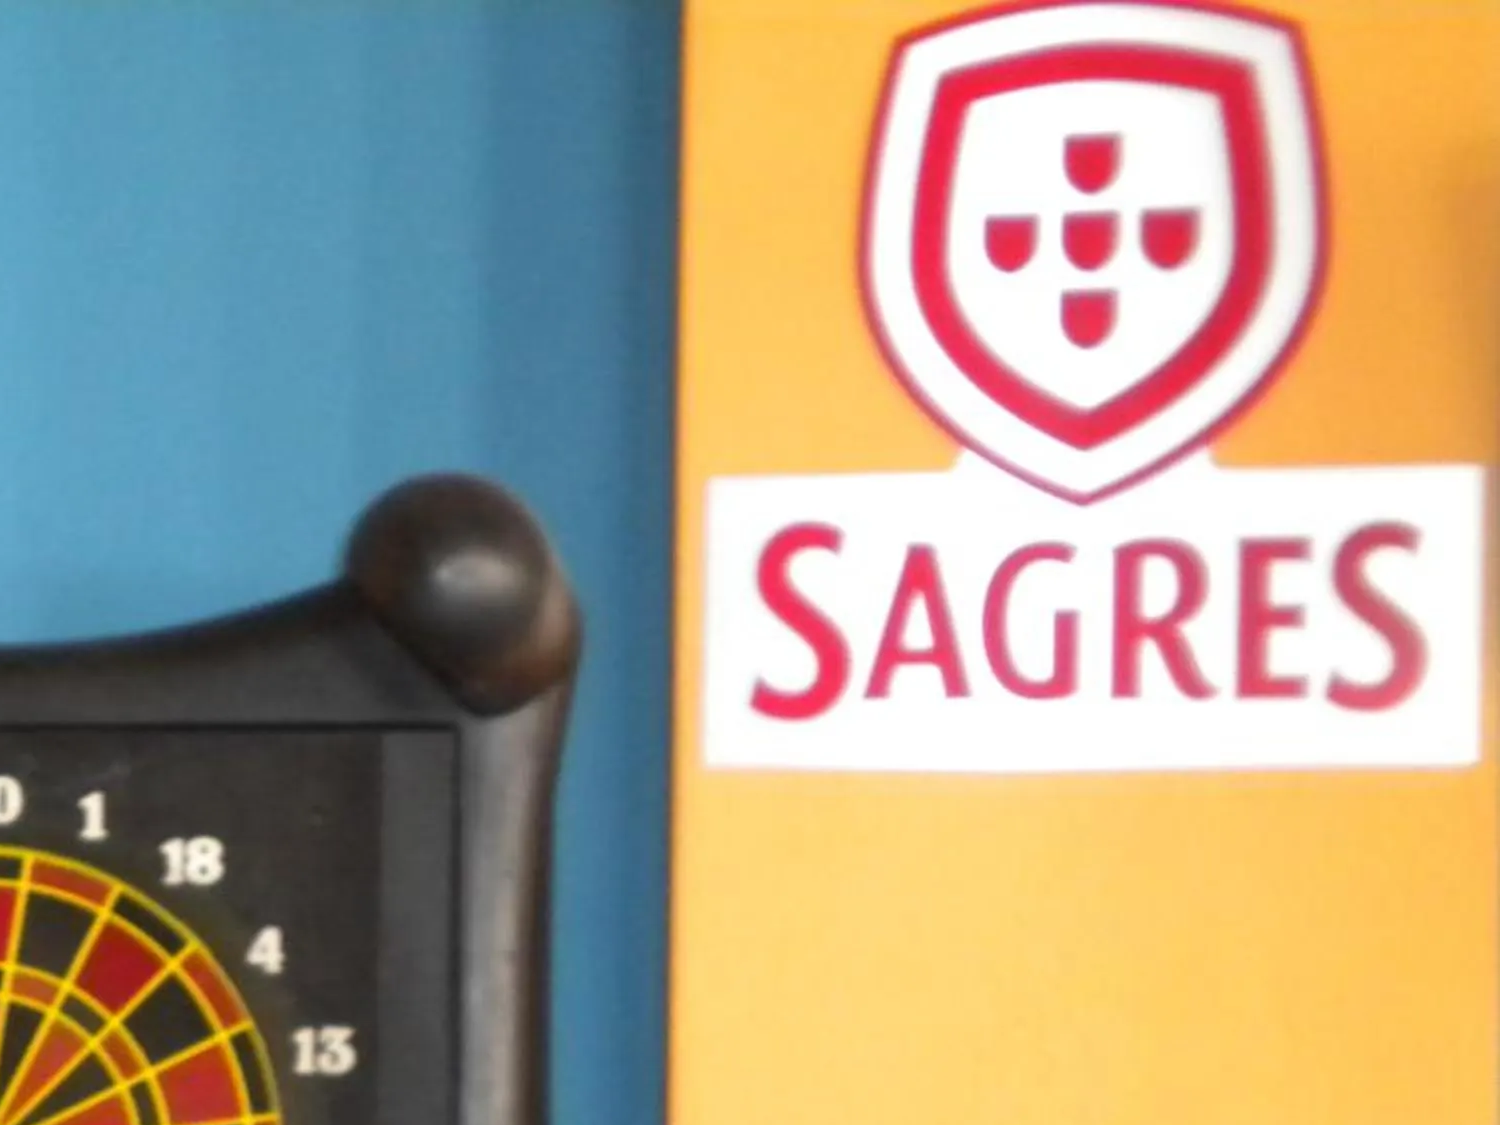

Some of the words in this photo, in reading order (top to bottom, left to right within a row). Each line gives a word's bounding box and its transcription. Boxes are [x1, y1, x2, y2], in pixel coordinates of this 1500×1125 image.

[749, 521, 1428, 721] SAGRES
[76, 790, 109, 843] 1
[158, 834, 226, 888] 18
[244, 924, 286, 976] 4
[290, 1024, 358, 1077] 13
